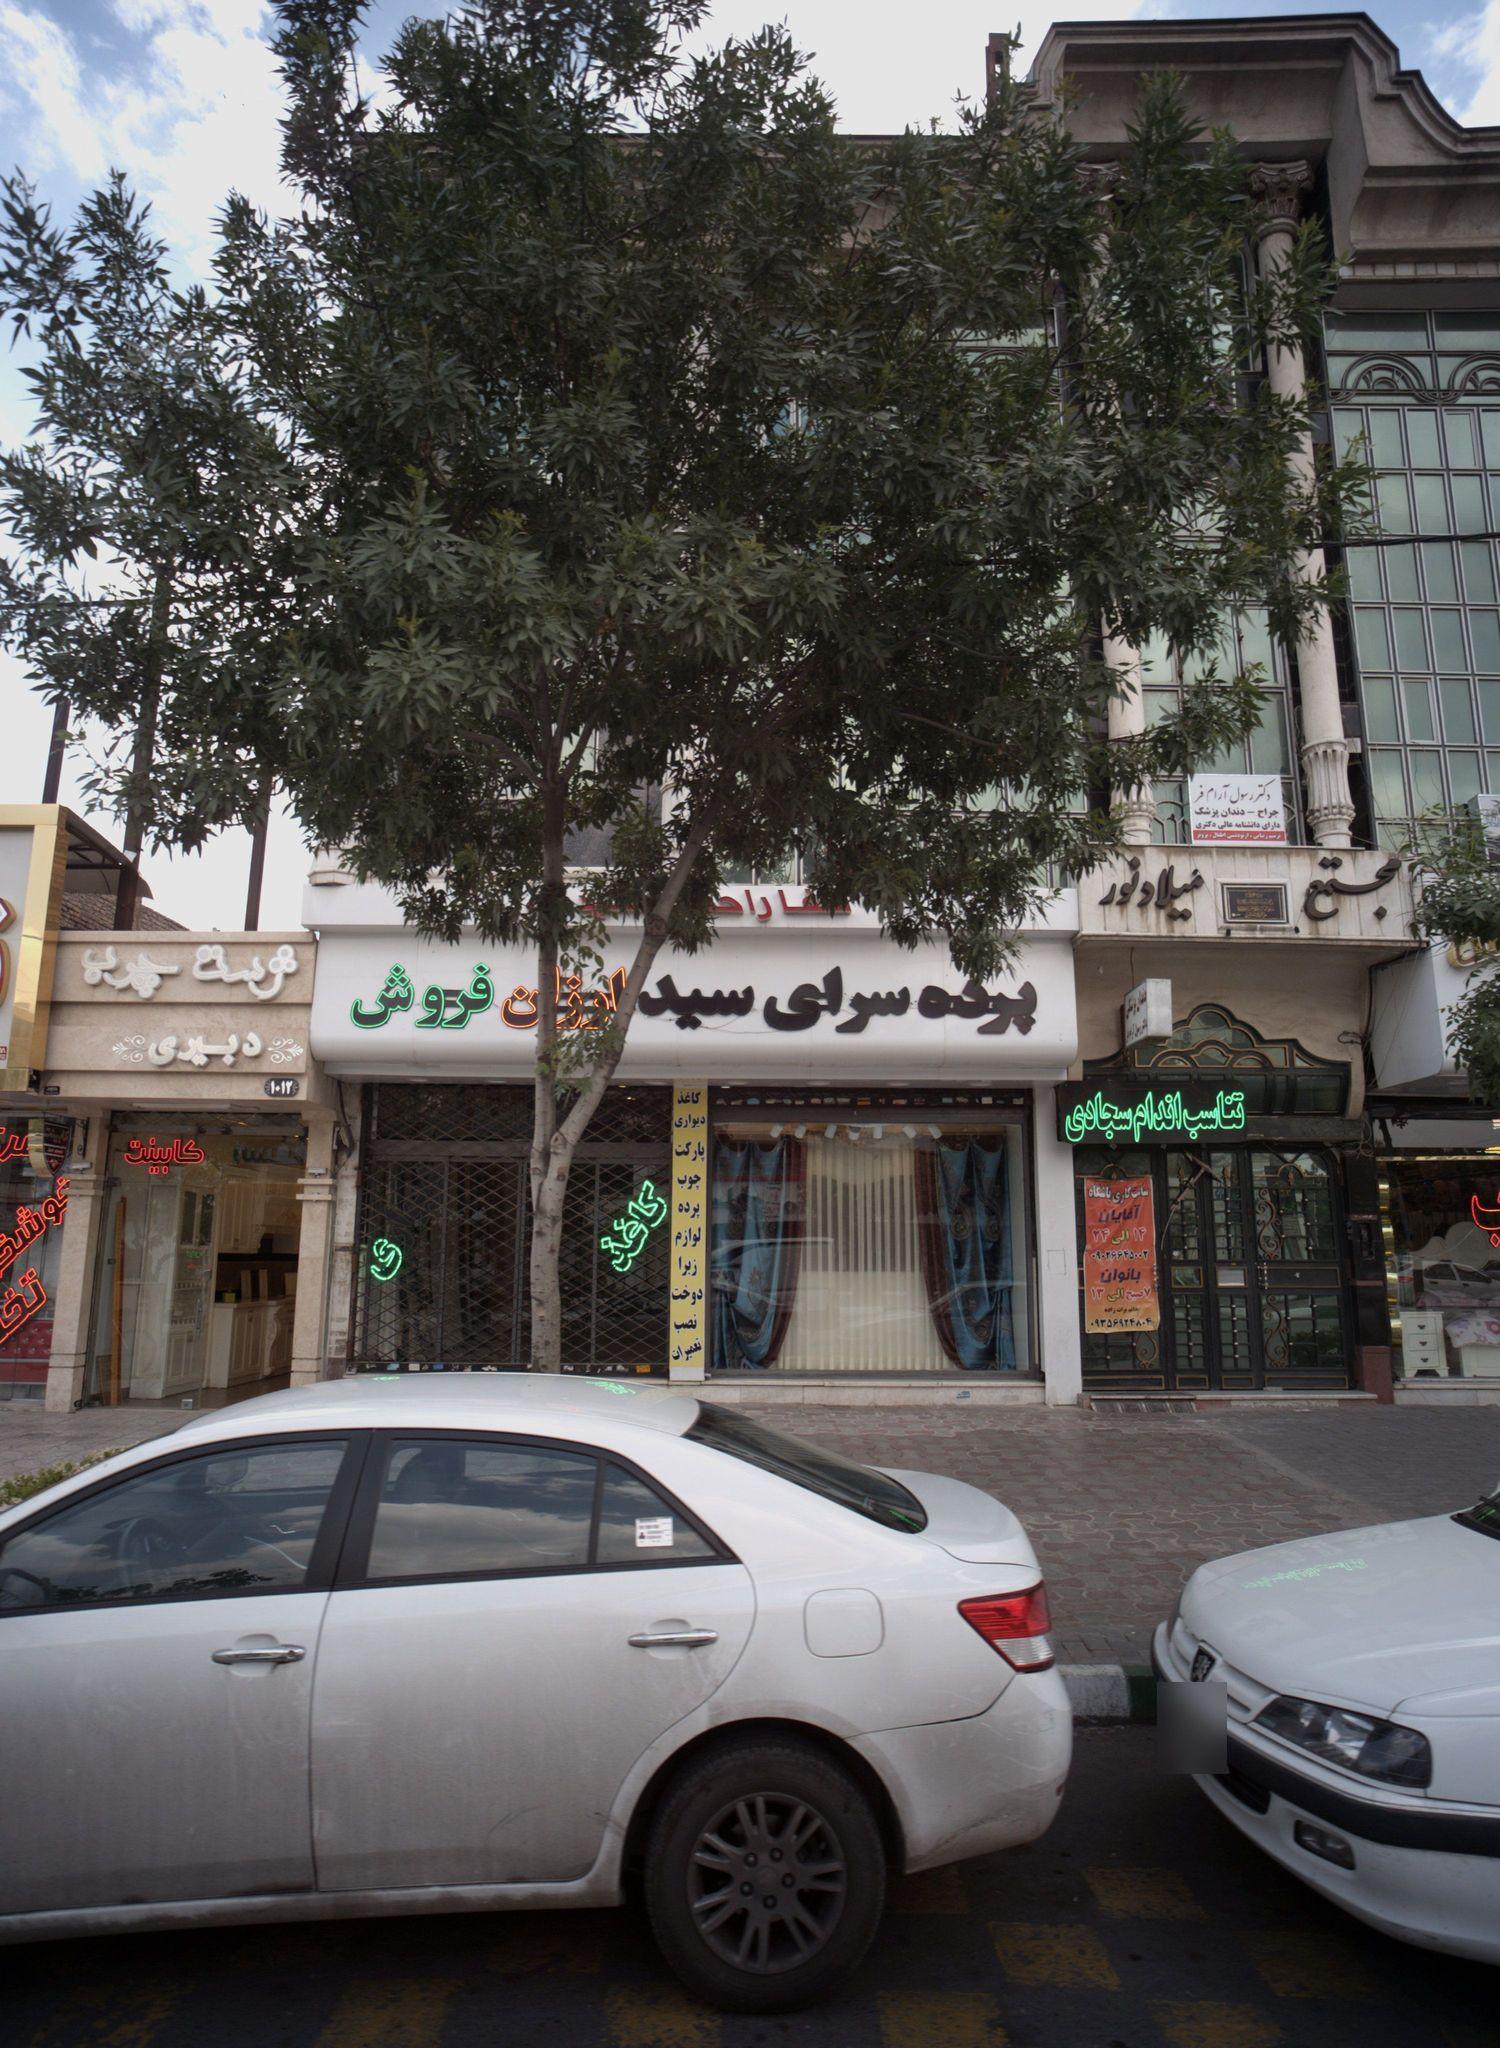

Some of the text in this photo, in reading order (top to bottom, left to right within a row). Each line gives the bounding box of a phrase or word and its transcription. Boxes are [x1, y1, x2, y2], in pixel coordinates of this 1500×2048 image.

[1194, 778, 1276, 804] دکتر رسول آرام فر
[1194, 806, 1279, 819] جراح دندان پزشک
[1195, 820, 1281, 830] دارای دانشنامه عالی دکتری
[1099, 856, 1141, 906] نور
[1304, 856, 1402, 921] مجتمع
[1137, 864, 1204, 921] میلاد
[350, 962, 494, 1030] فروش
[636, 973, 755, 1031] سید
[763, 966, 911, 1034] سرای
[917, 975, 1038, 1036] پرده
[148, 1031, 262, 1067] دبیری
[269, 1081, 294, 1095] ۱۰۱۲
[677, 1090, 701, 1105] کاغذ
[674, 1113, 706, 1129] دیواری
[1065, 1090, 1245, 1143] تناسب اندام سجادی
[123, 1137, 205, 1175] کابینت
[674, 1141, 705, 1162] پارکت
[677, 1172, 701, 1191] چوب
[1088, 1184, 1111, 1199] باشگاه
[677, 1201, 700, 1219] پرده
[1098, 1204, 1142, 1223] آقایان
[675, 1226, 702, 1248] لوازم
[1111, 1227, 1130, 1245] الی
[1100, 1267, 1142, 1284] بانوان
[671, 1284, 703, 1306] دوخت
[1107, 1287, 1125, 1302] الی
[673, 1314, 698, 1334] نصب
[671, 1338, 703, 1361] تعمیرات
